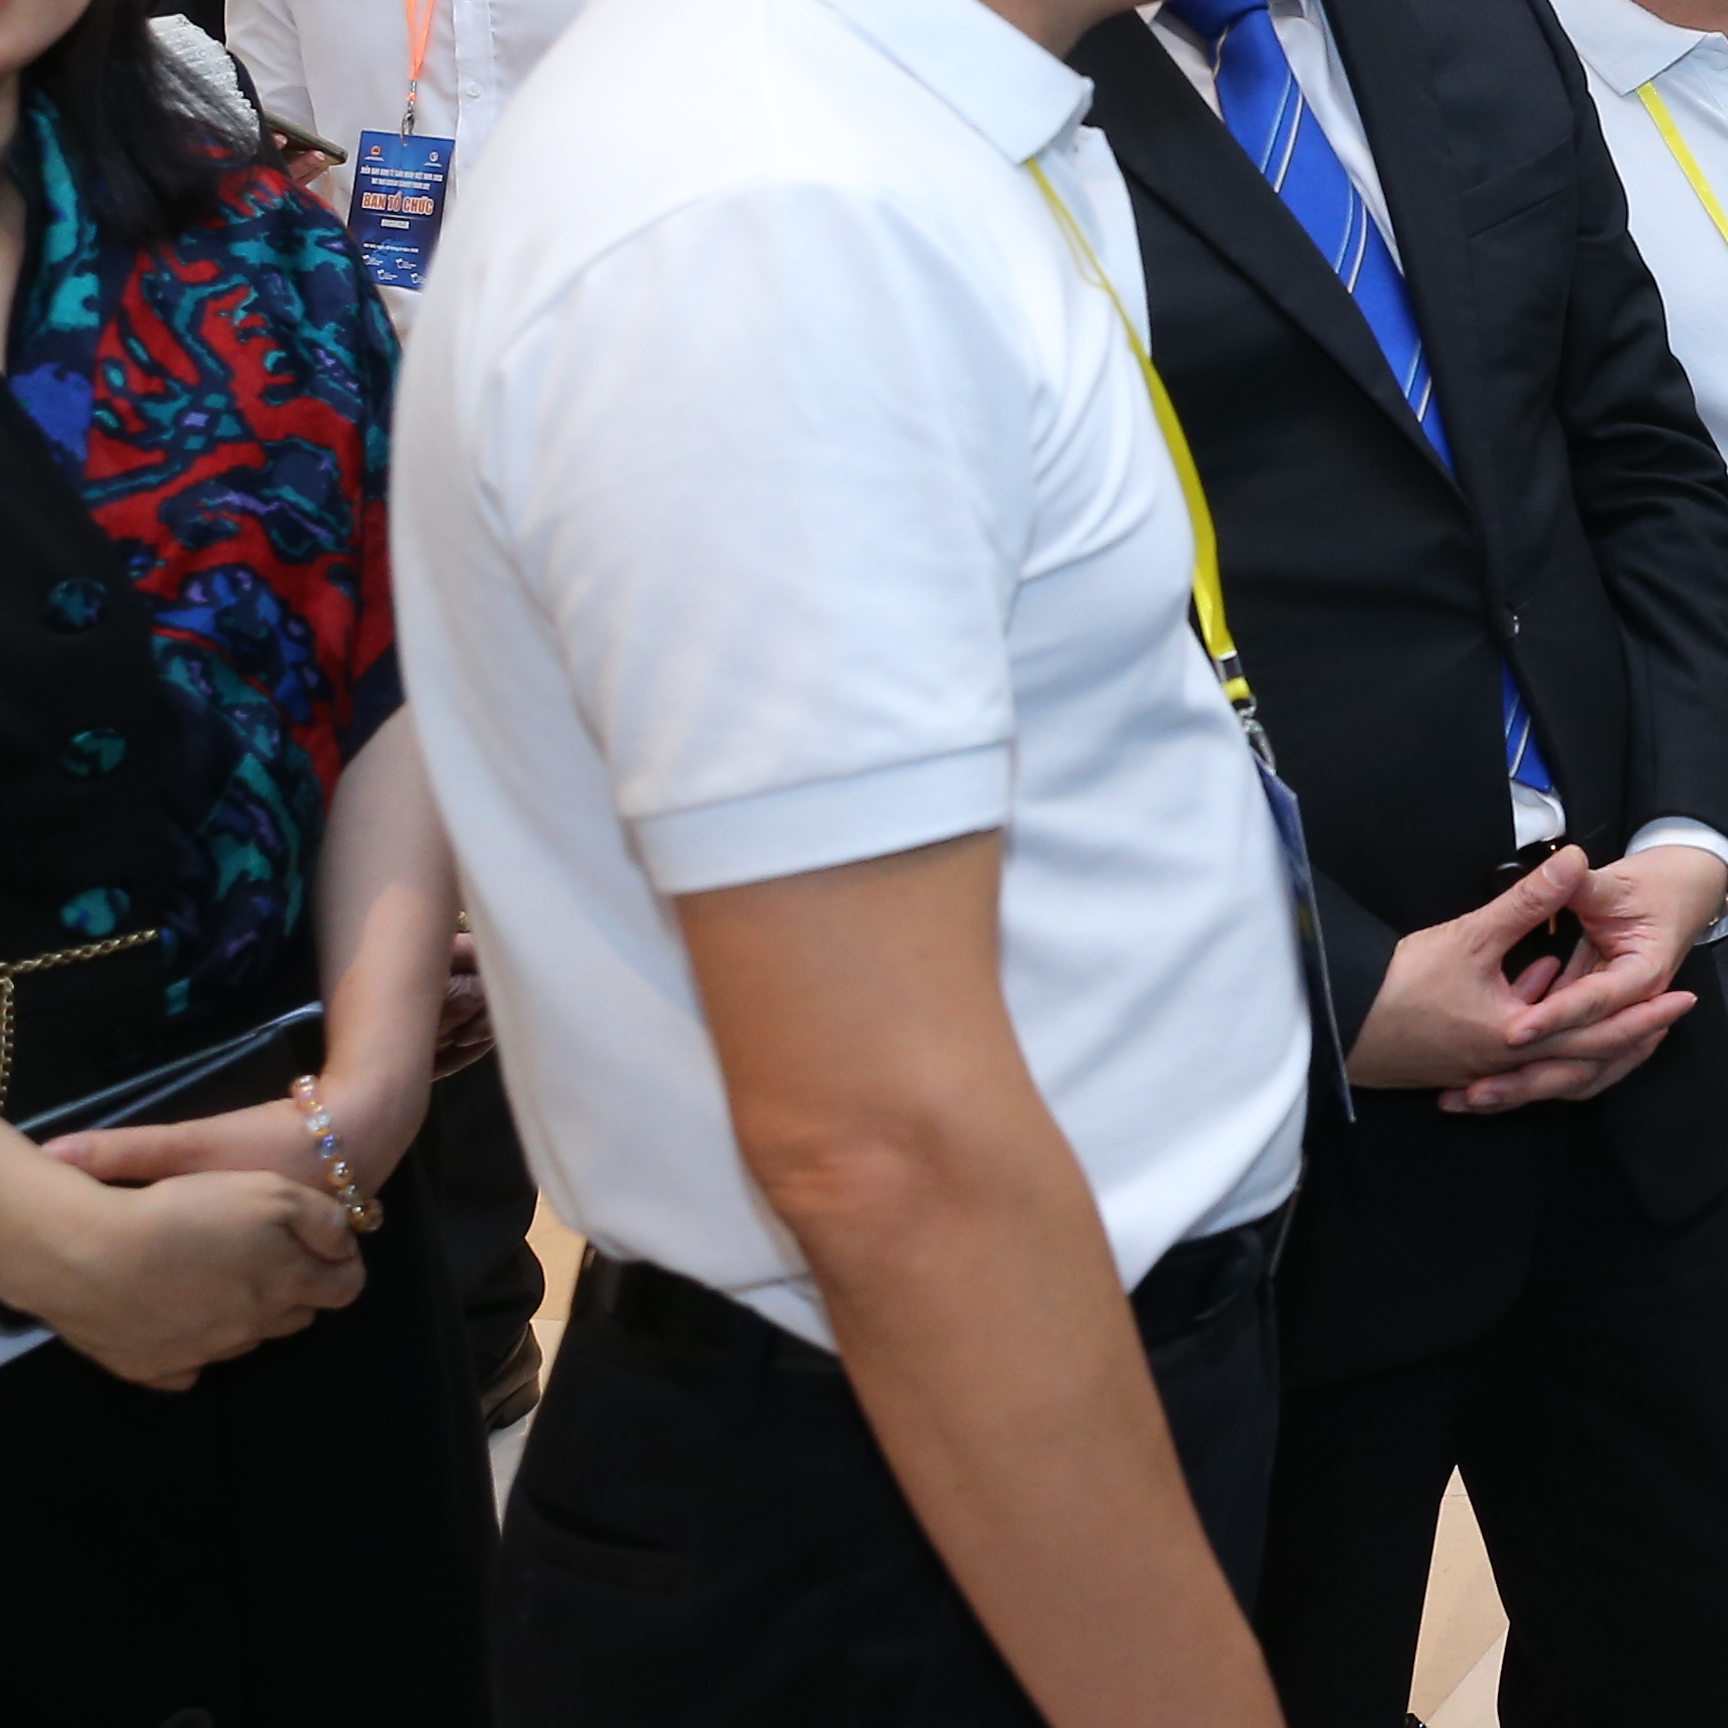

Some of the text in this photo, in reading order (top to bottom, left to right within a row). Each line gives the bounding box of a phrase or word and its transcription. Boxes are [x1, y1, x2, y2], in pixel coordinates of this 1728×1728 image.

[361, 191, 434, 216] BAN TỔ CHỨC
